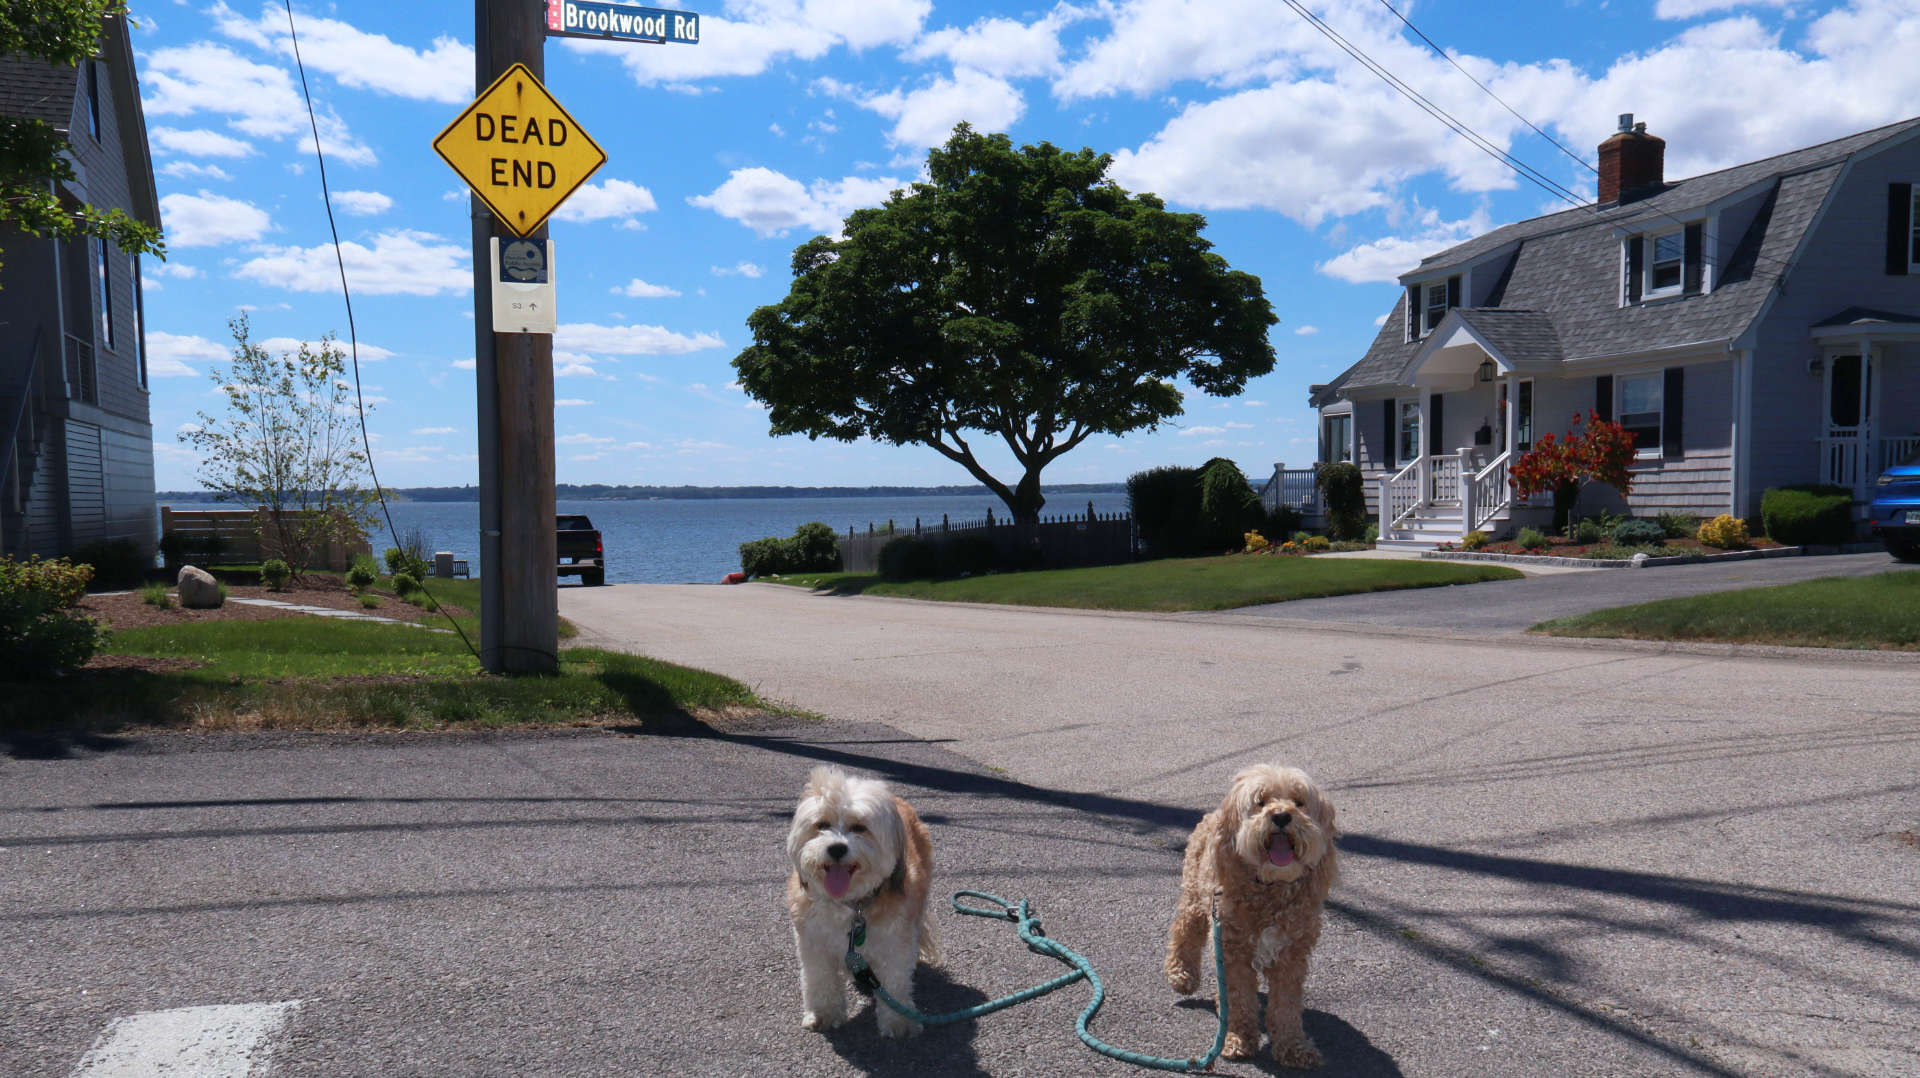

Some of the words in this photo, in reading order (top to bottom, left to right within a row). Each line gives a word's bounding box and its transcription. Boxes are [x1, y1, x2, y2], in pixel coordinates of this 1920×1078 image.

[566, 3, 666, 37] Brookwood
[476, 113, 567, 146] DEAD
[491, 158, 556, 189] END
